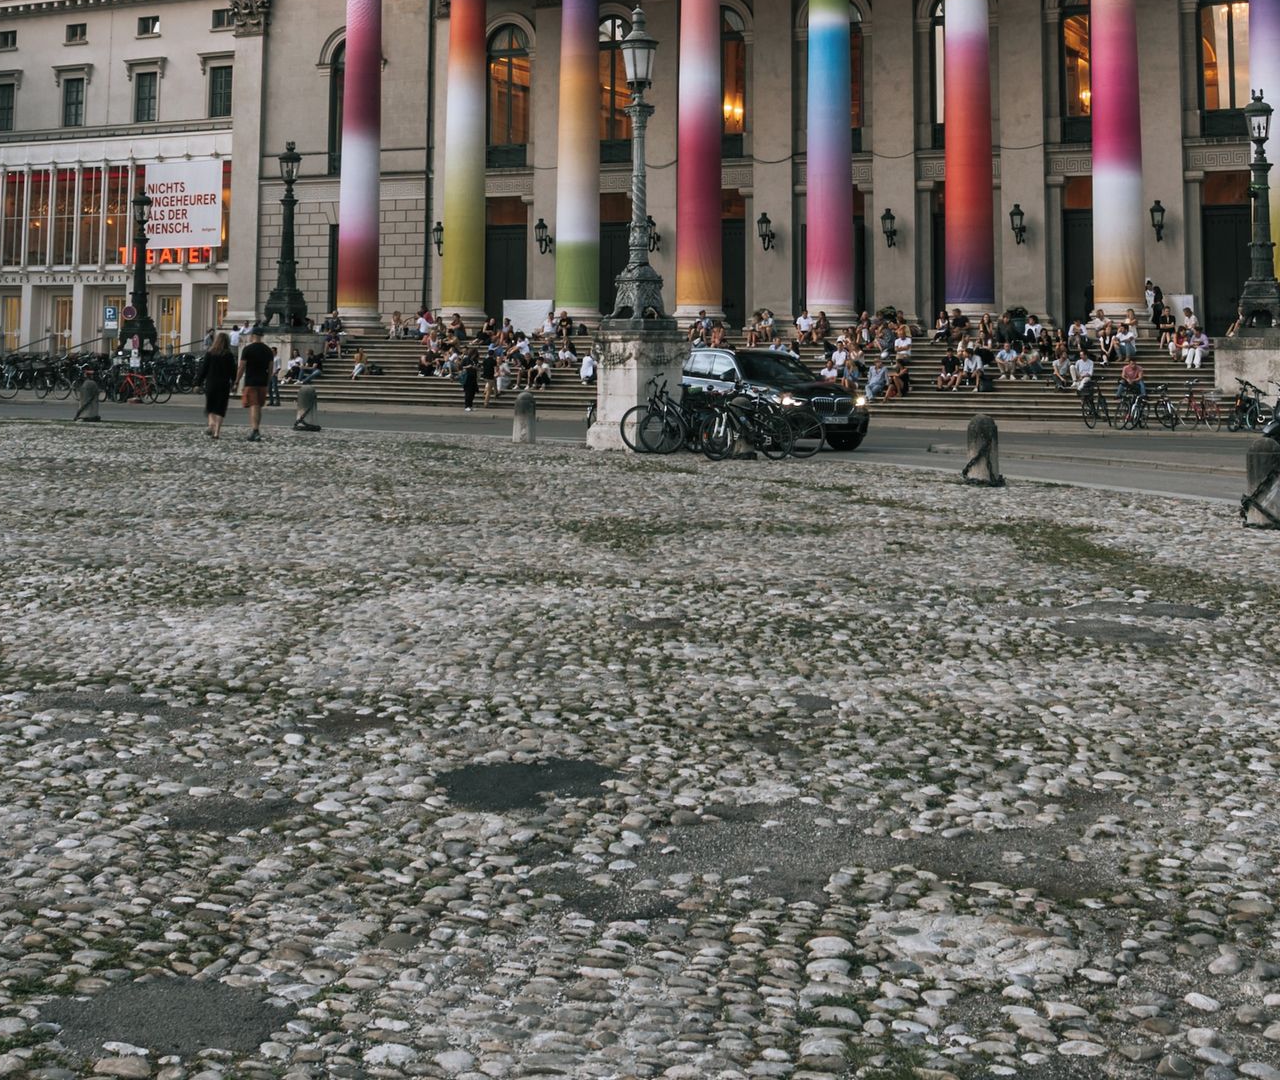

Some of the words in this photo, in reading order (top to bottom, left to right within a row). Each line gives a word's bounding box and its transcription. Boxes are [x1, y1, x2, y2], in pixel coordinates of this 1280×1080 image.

[148, 182, 185, 194] NICHTS
[148, 209, 165, 221] ALS
[168, 209, 188, 220] DER
[147, 222, 192, 235] MENSCH.
[39, 275, 151, 284] STAATSSCHAUSPL
